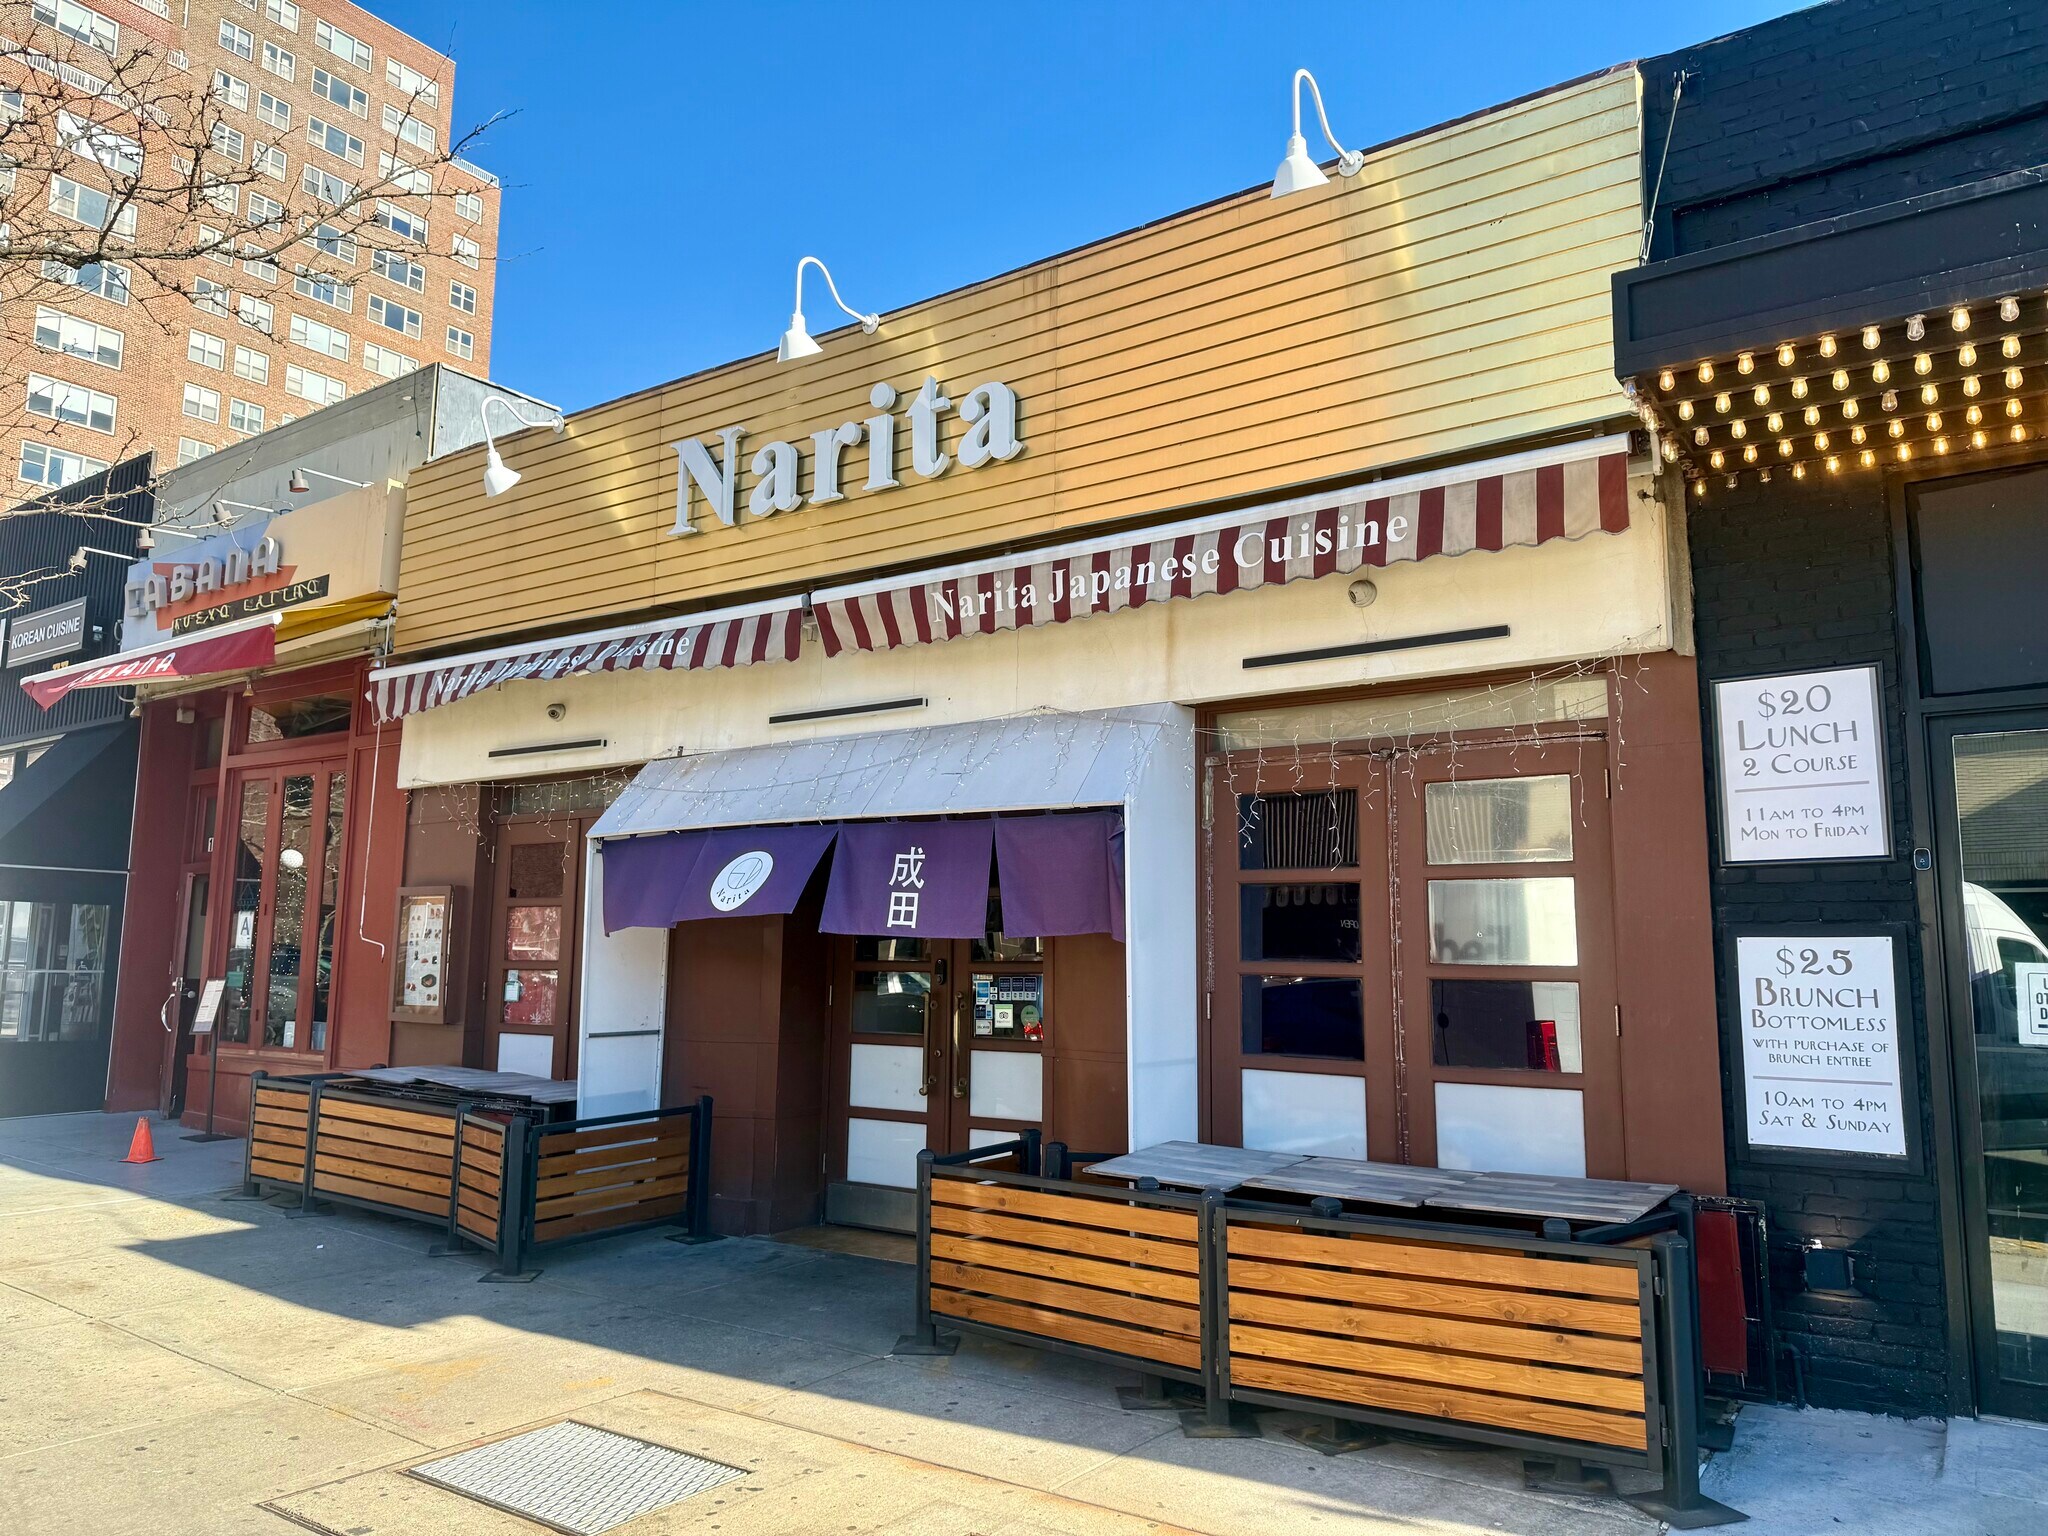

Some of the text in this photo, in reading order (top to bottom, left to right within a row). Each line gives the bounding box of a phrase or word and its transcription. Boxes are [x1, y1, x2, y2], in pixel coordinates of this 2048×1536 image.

[666, 375, 1026, 538] Narita
[125, 536, 281, 617] CABANA
[931, 514, 1408, 622] Narita Japanese Cuisine
[11, 616, 81, 650] KOREAN CUISINE
[431, 636, 690, 697] Narita Japanese Cuisine
[1757, 684, 1832, 721] $20
[1742, 757, 1760, 777] 2
[1801, 807, 1824, 819] TO
[1786, 828, 1808, 839] TO
[716, 888, 751, 904] Narita
[886, 846, 926, 929] 成田
[240, 916, 250, 936] A
[1775, 945, 1853, 979] $25
[1752, 1038, 1890, 1053] WITH PURCHASE OF
[1768, 1053, 1872, 1067] BRUNCH ENTREE
[1821, 1098, 1844, 1110] TO
[1801, 1112, 1818, 1128] &
